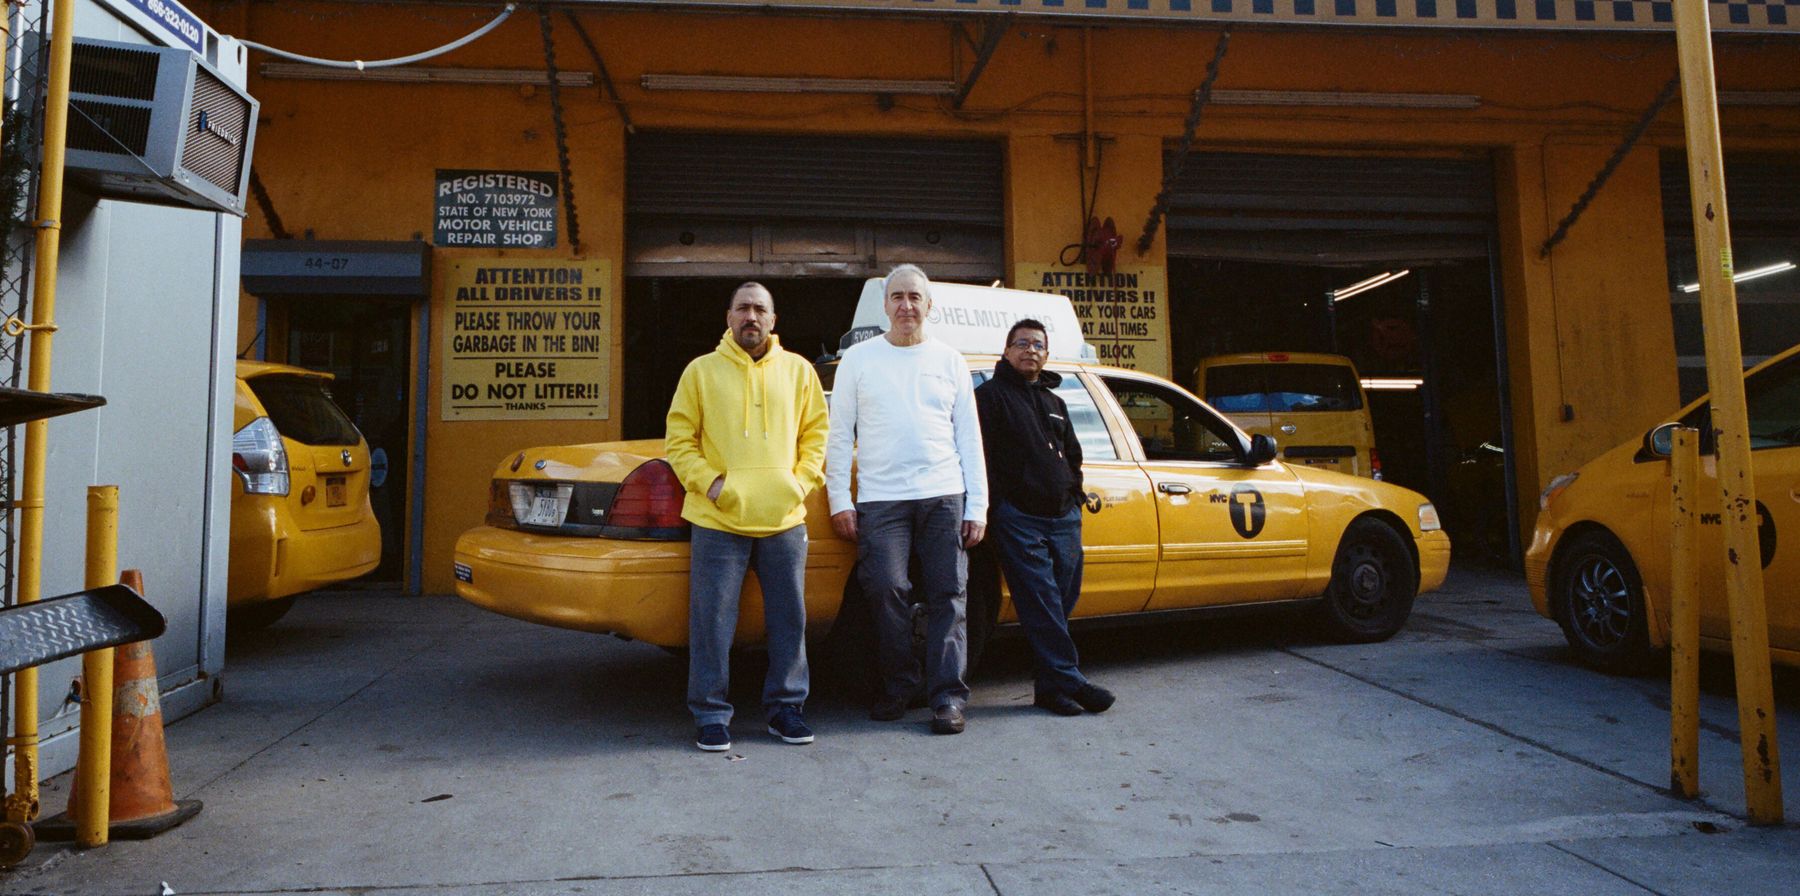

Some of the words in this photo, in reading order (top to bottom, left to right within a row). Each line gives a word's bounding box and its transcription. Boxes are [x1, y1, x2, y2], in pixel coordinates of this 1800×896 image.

[439, 174, 553, 198] REGISTERED
[457, 193, 479, 205] NO.
[484, 193, 535, 205] 7103972
[439, 206, 468, 217] STATE
[473, 206, 488, 217] OF
[492, 207, 518, 217] NEW
[523, 207, 552, 218] YORK
[438, 219, 491, 230] MOTOR
[498, 220, 553, 232] VEHICLE
[447, 233, 496, 244] REPAIR
[503, 233, 543, 245] SHOP
[304, 258, 349, 270] 44-07
[475, 268, 583, 285] ATTENTION
[1042, 272, 1138, 288] ATTENTION
[456, 287, 490, 301] ALL
[494, 287, 582, 301] DRIVERS
[1060, 289, 1139, 304] DRIVERS
[942, 307, 1008, 329] HELMUT
[1073, 304, 1093, 318] ARK
[1097, 304, 1126, 319] YOUR
[1130, 305, 1156, 320] CARS
[455, 312, 500, 331] PLEASE
[506, 311, 557, 331] THROW
[562, 311, 601, 331] YOUR
[1098, 322, 1116, 336] ALL
[1119, 322, 1148, 336] TIMES
[453, 334, 516, 353] GARBAGE
[522, 335, 537, 352] IN
[543, 335, 566, 352] THE
[572, 335, 599, 352] BIN!
[1100, 344, 1136, 359] BLOCK
[495, 362, 556, 378] PLEASE
[452, 384, 479, 400] DO
[487, 383, 526, 400] NOT
[535, 383, 599, 400] LITTER!!
[505, 402, 546, 411] THANKS
[1209, 493, 1228, 504] NYC
[1700, 513, 1722, 525] NYC
